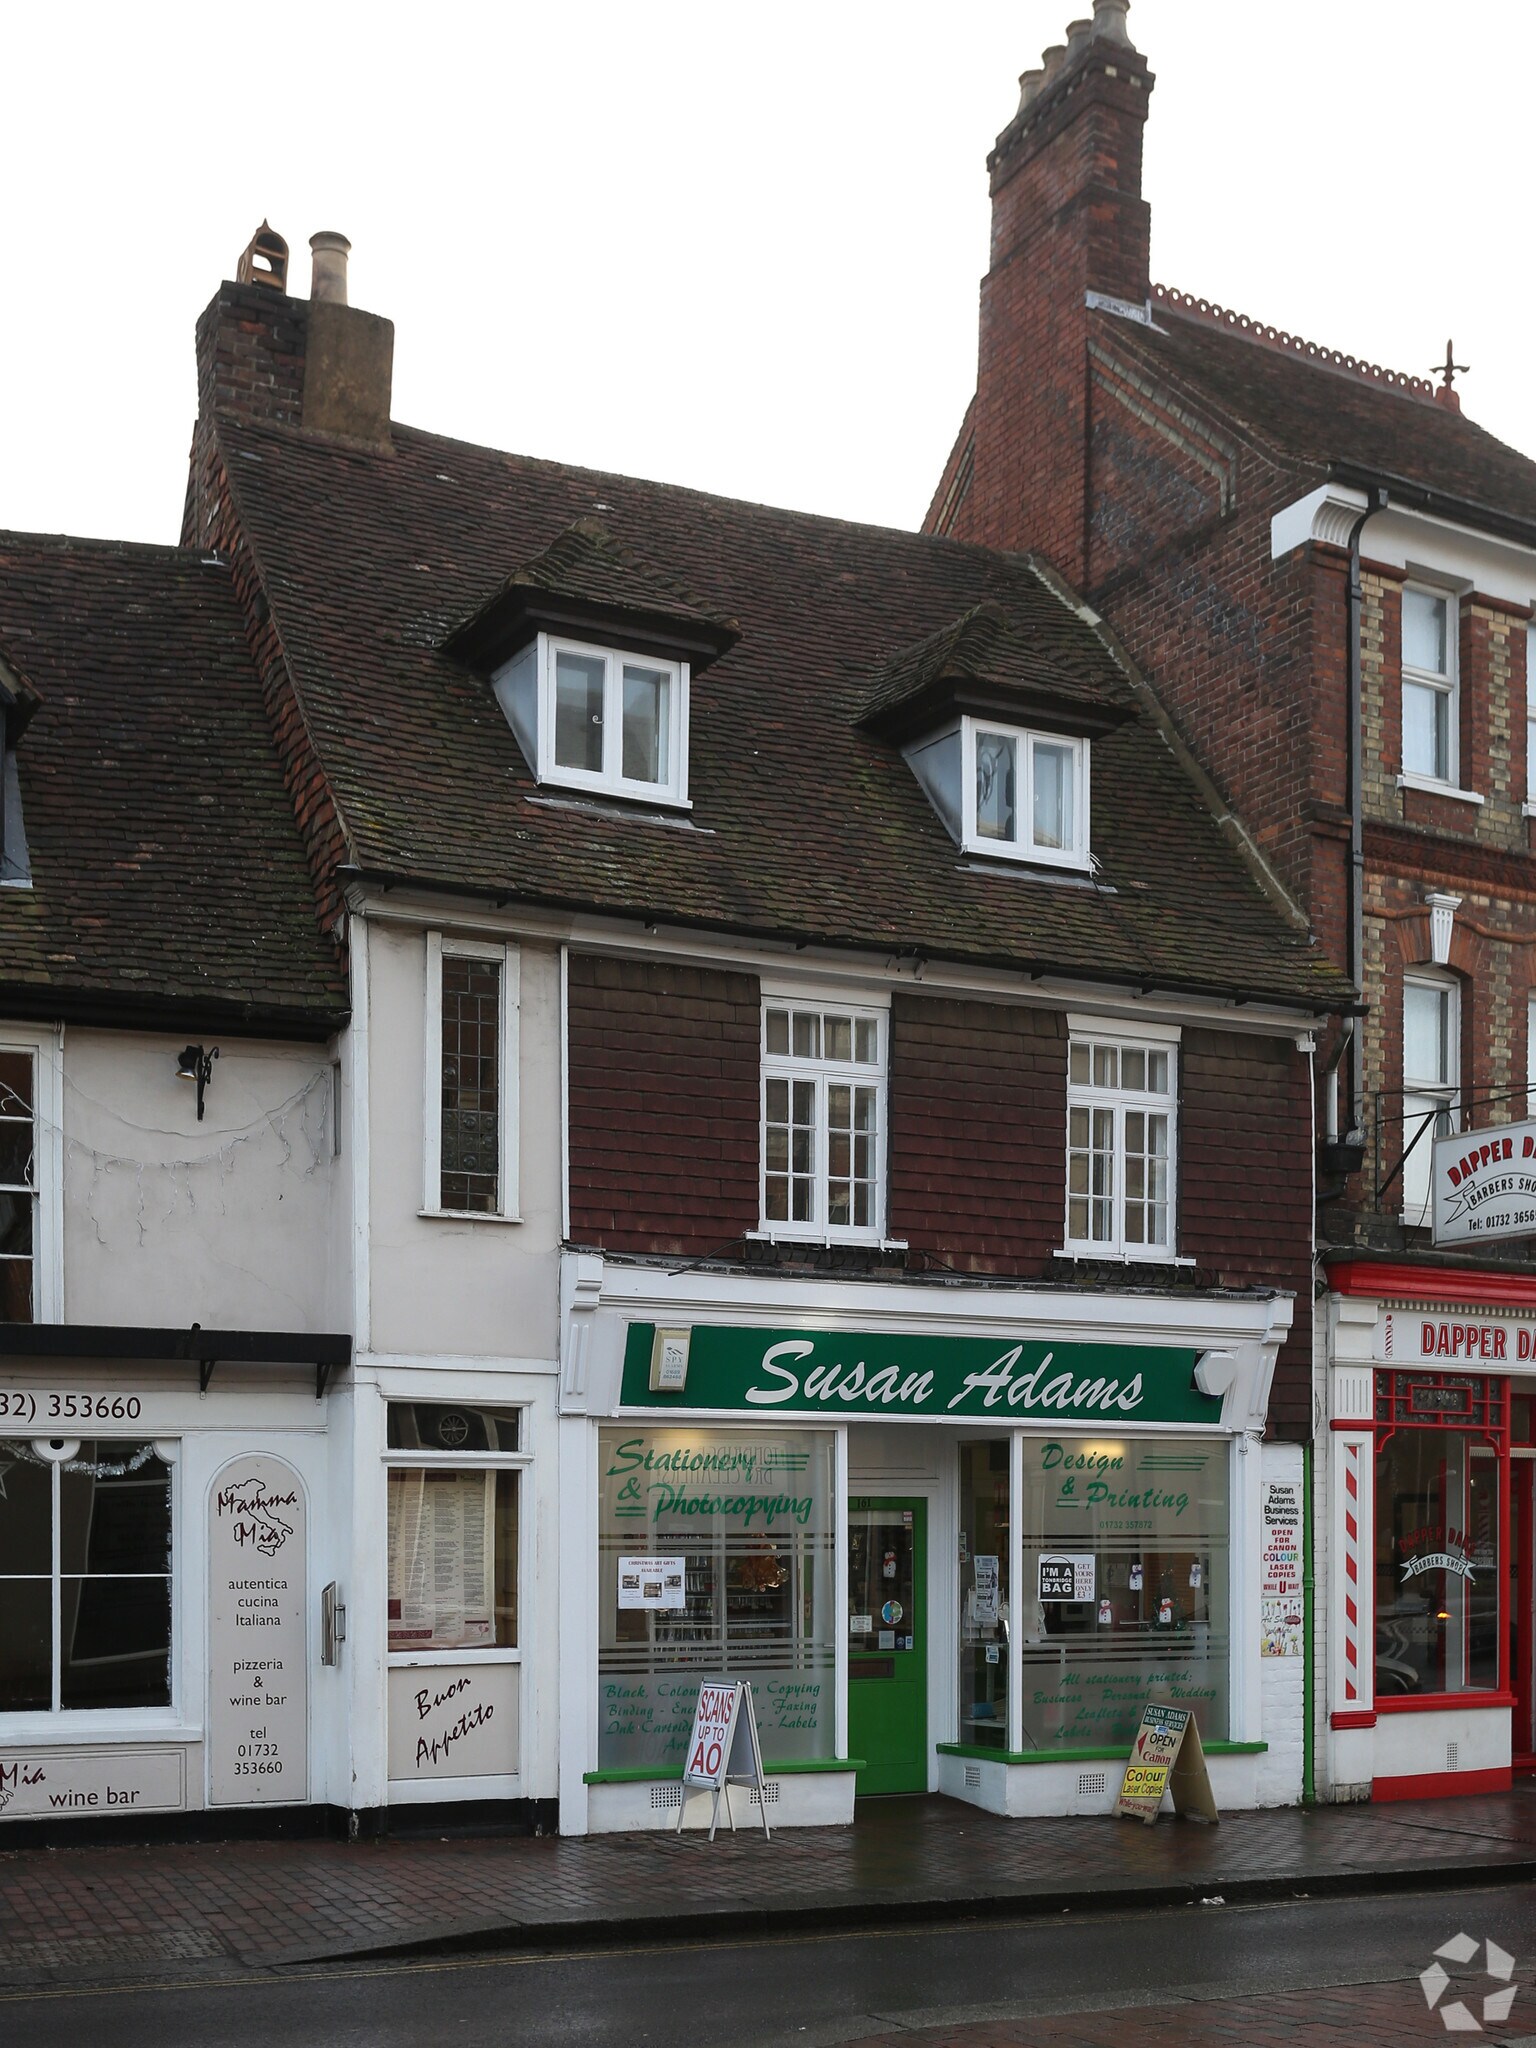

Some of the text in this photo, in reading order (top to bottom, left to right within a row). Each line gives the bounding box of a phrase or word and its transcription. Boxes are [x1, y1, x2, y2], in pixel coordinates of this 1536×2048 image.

[1447, 1136, 1536, 1187] DAPPER D
[1470, 1178, 1514, 1206] BARBERS
[1468, 1209, 1536, 1231] Tel: 01732 3656
[1421, 1321, 1508, 1360] DAPPER
[745, 1340, 1144, 1410] Susan Adams
[48, 1394, 141, 1419] 353660
[606, 1438, 757, 1482] Stationery
[1041, 1443, 1124, 1478] Design
[1061, 1476, 1189, 1516] & Printing
[1269, 1485, 1294, 1495] Susan
[218, 1491, 297, 1516] Mamma
[617, 1477, 813, 1527] & Photocopying
[1268, 1495, 1295, 1505] Adams
[1264, 1505, 1299, 1515] Business
[1100, 1521, 1123, 1529] 01732
[1265, 1516, 1298, 1525] Services
[239, 1522, 281, 1547] Mia
[1398, 1526, 1442, 1553] DAPPER
[1263, 1553, 1299, 1562] COLOUR
[1414, 1556, 1444, 1573] BARBERS
[1446, 1557, 1464, 1572] SHOP
[1042, 1567, 1072, 1577] I'M A
[228, 1578, 288, 1590] autentica
[1042, 1583, 1072, 1593] BAG
[1279, 1581, 1287, 1594] U
[238, 1596, 279, 1608] cucina
[236, 1614, 281, 1626] Italiana
[233, 1658, 283, 1674] pizzeria
[253, 1676, 263, 1688] &
[1059, 1670, 1193, 1687] All stationery printed:
[603, 1684, 649, 1699] Black,
[767, 1680, 820, 1698] Copying
[1033, 1691, 1082, 1704] Business
[1102, 1688, 1151, 1702] Personal
[1170, 1686, 1217, 1701] Wedding
[229, 1693, 287, 1706] wine bar
[414, 1678, 471, 1720] Buon
[698, 1690, 734, 1724] SCANS
[607, 1704, 654, 1720] Binding
[772, 1699, 817, 1714] Faxing
[1075, 1707, 1123, 1721] Leaflets
[1147, 1707, 1187, 1722] SUSAN ADAMS
[605, 1720, 635, 1735] Ink
[778, 1715, 818, 1729] Labels
[1144, 1715, 1184, 1730] BUSINESS SERVICES
[250, 1726, 267, 1739] tel
[415, 1703, 494, 1768] Appetito
[698, 1726, 725, 1742] UP TO
[1149, 1733, 1177, 1748] OPEN
[238, 1743, 279, 1757] 01732
[1143, 1751, 1171, 1765] Canon
[234, 1761, 283, 1775] 353660
[1126, 1769, 1165, 1782] Colour
[0, 1762, 46, 1792] Mia
[48, 1786, 140, 1807] wine bar
[1122, 1783, 1163, 1796] Laser Copies
